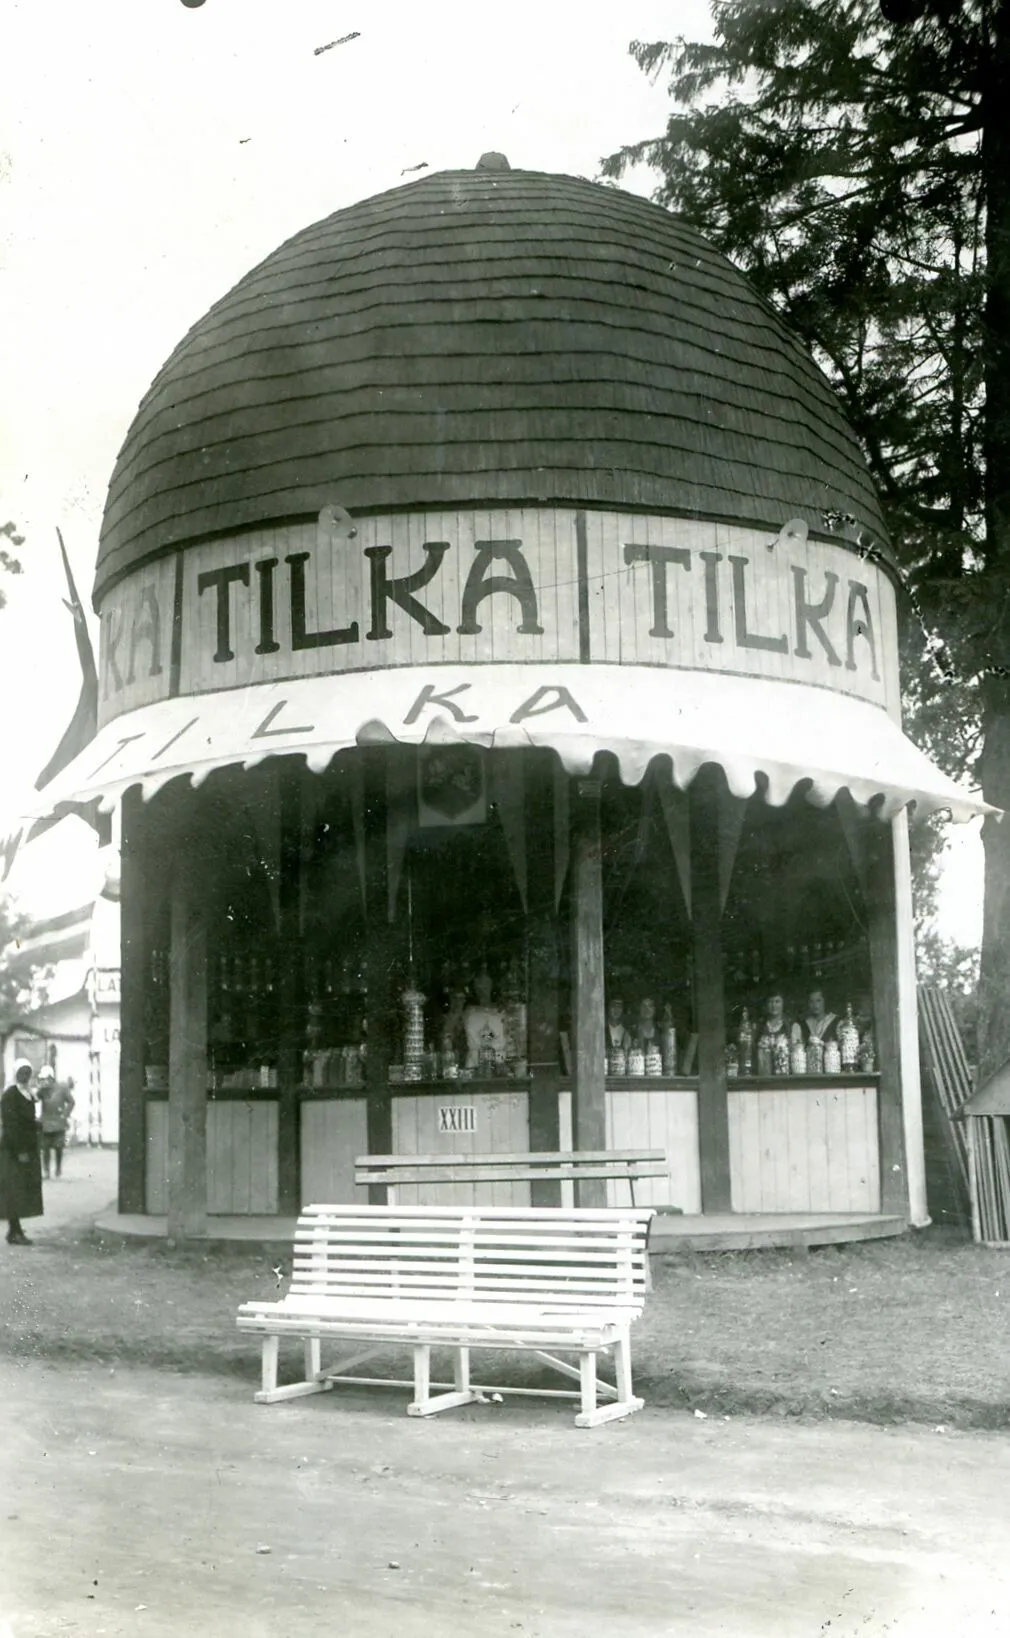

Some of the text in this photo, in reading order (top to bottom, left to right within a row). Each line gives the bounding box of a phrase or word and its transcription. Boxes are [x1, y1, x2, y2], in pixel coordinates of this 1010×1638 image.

[197, 539, 544, 662] TILKA
[623, 543, 880, 681] TILKA
[87, 683, 588, 779] TILKA
[440, 1108, 475, 1130] XXIII
